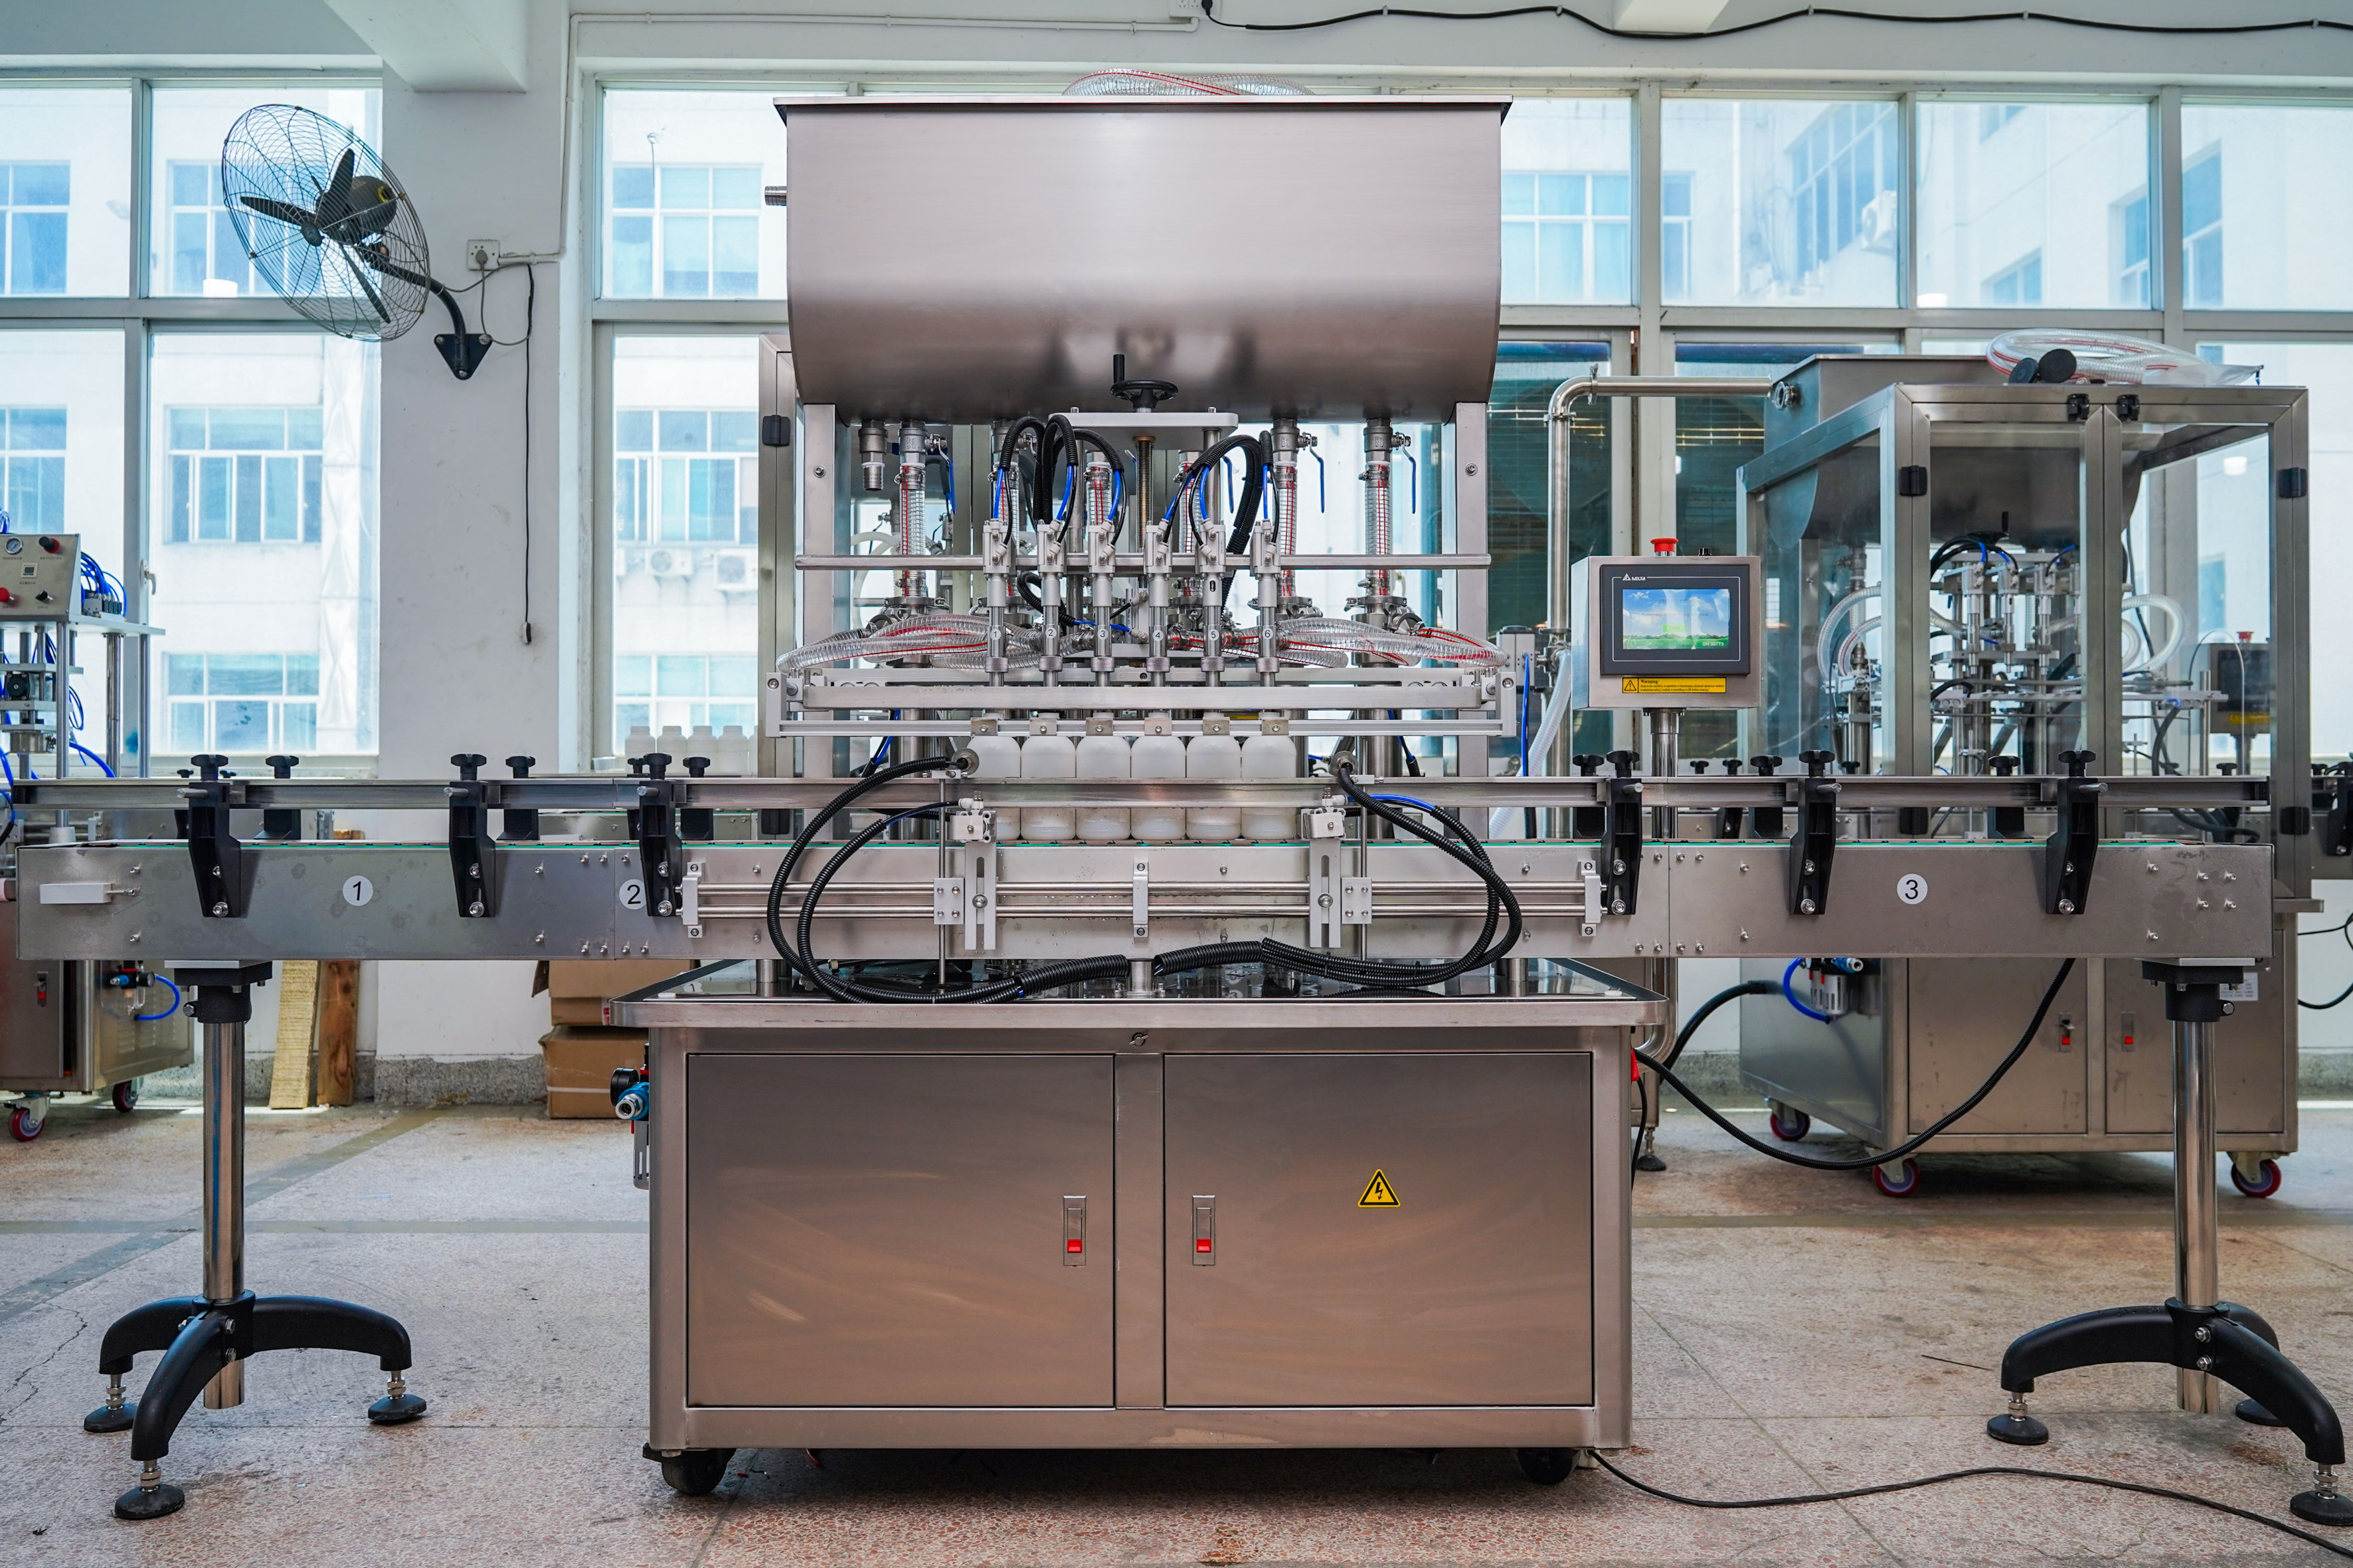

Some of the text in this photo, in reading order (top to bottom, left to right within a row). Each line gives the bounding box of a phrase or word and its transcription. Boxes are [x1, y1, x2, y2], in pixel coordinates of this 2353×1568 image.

[353, 881, 361, 901] 1
[627, 884, 642, 905] 2
[1905, 879, 1919, 900] 3
